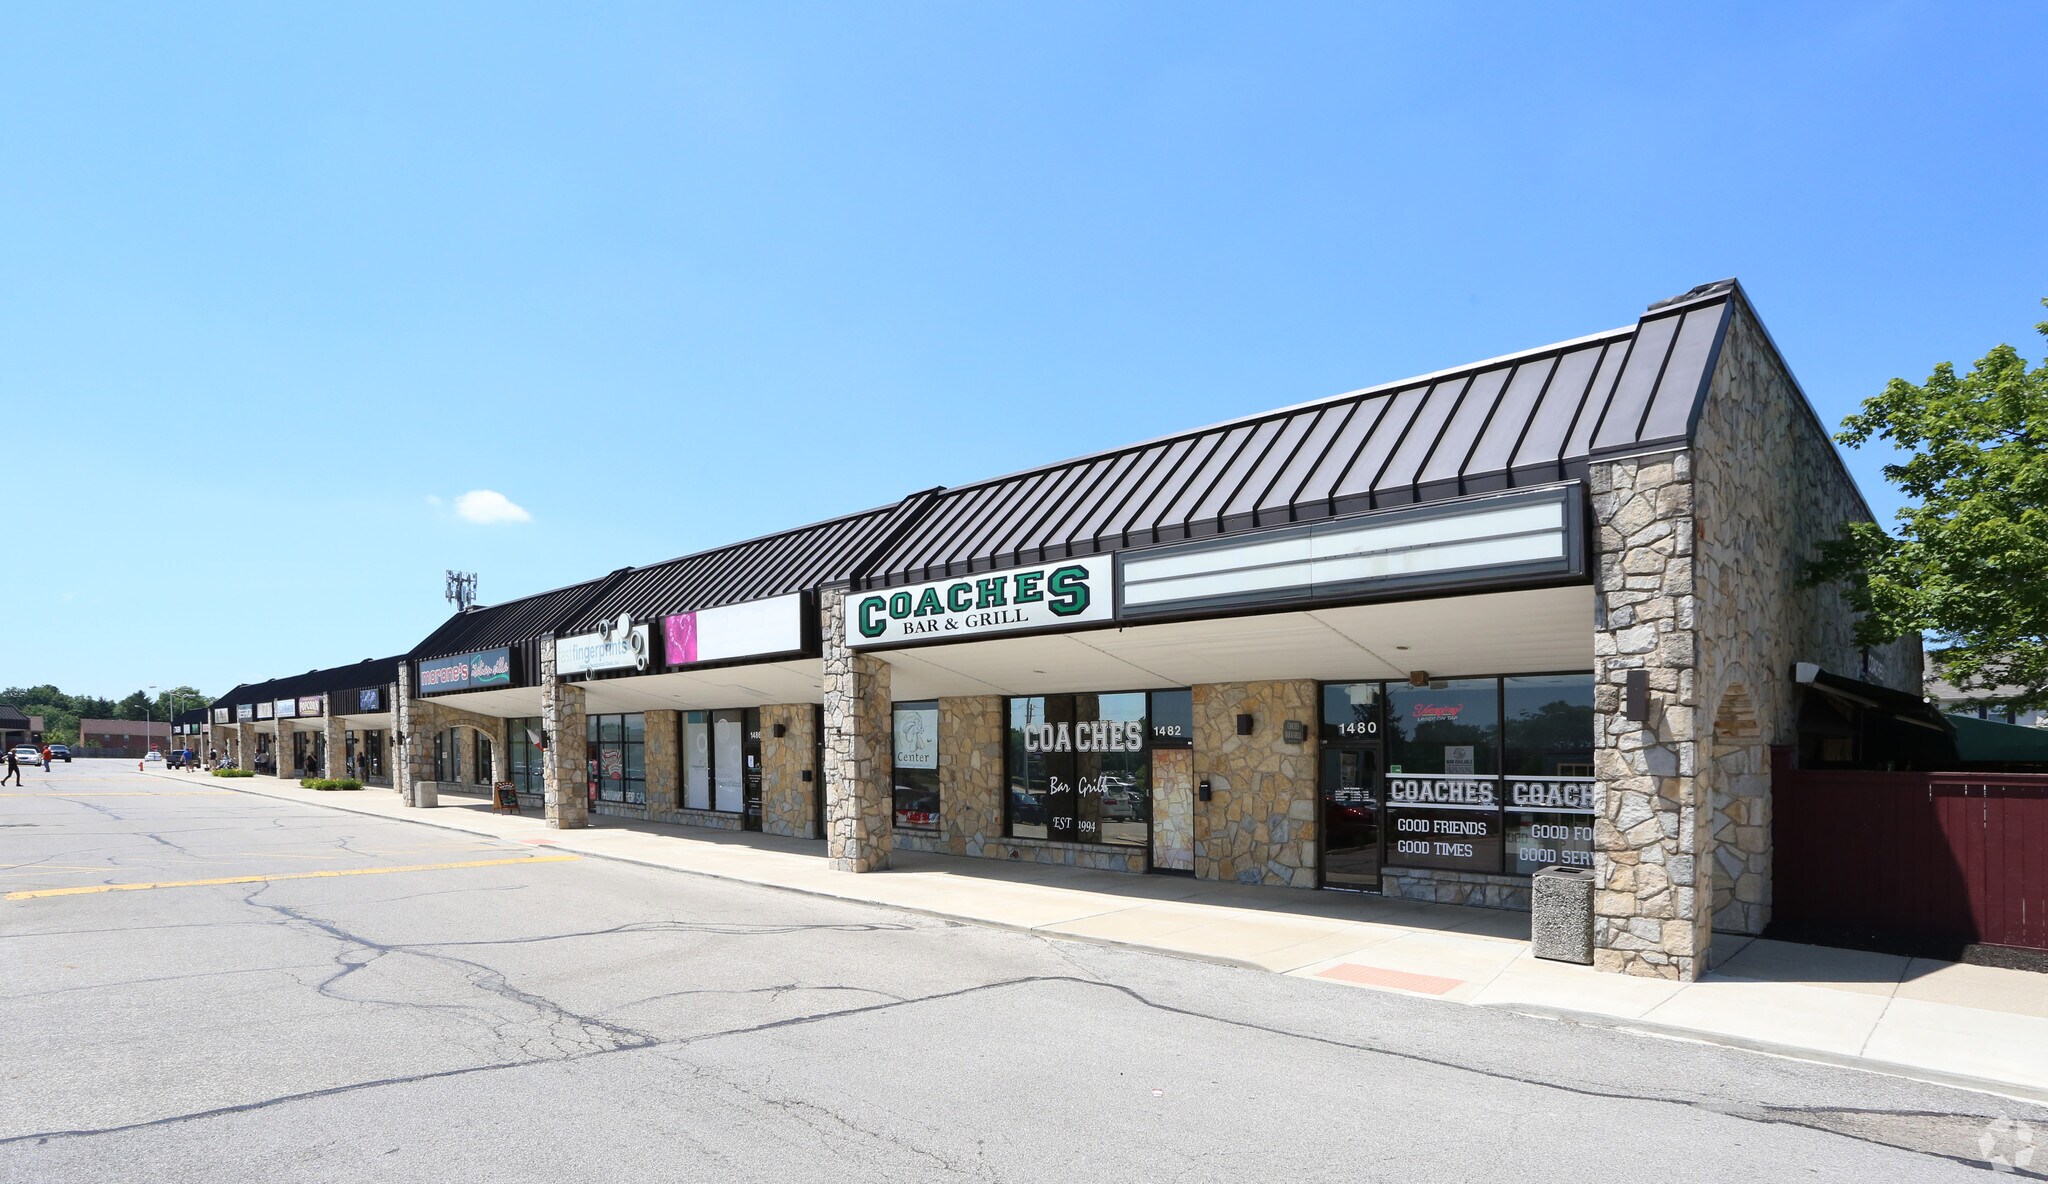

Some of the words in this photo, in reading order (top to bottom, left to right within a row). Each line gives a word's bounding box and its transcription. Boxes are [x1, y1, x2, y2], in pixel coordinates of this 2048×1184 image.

[858, 564, 1091, 639] COACHES
[903, 619, 939, 635] BAR
[944, 617, 960, 631] &
[965, 608, 1029, 628] GRILL
[1024, 720, 1143, 753] COACHES
[1153, 725, 1182, 736] 1482
[1339, 721, 1377, 734] 1480
[897, 752, 930, 762] Center
[1049, 776, 1071, 795] Bar
[1078, 775, 1109, 797] Grill
[1390, 779, 1494, 803] COACHES
[1512, 782, 1595, 808] COACH
[1052, 816, 1072, 830] EST
[1077, 821, 1096, 833] 1994
[1397, 818, 1430, 833] GOOD
[1433, 820, 1487, 836] FRIENDS
[1531, 824, 1569, 841] GOOD
[1574, 826, 1595, 841] FO
[1397, 840, 1430, 855] GOOD
[1434, 842, 1473, 858] TIMES
[1519, 847, 1557, 863] GOOD
[1561, 850, 1595, 866] SERV
